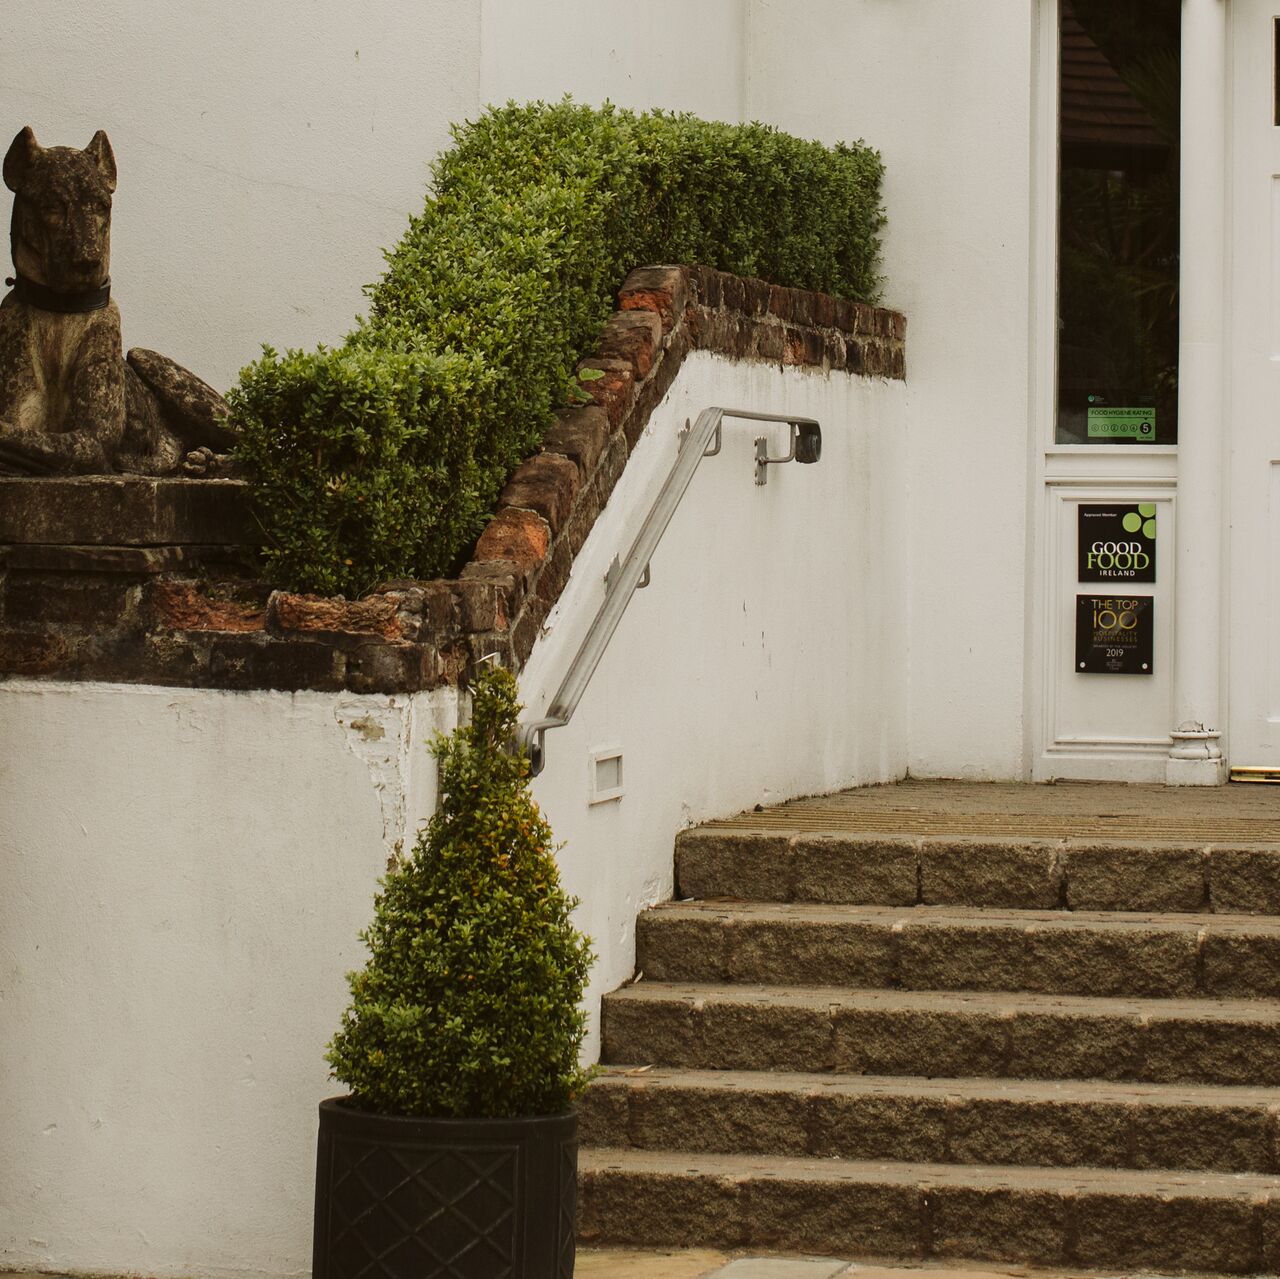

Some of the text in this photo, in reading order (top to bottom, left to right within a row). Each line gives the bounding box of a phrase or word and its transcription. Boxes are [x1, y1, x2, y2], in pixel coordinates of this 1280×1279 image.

[1091, 542, 1142, 555] GOOD
[1087, 553, 1150, 570] FOOD
[1091, 599, 1138, 610] THE TOP
[1093, 609, 1138, 630] 100
[1106, 649, 1124, 657] 2019
